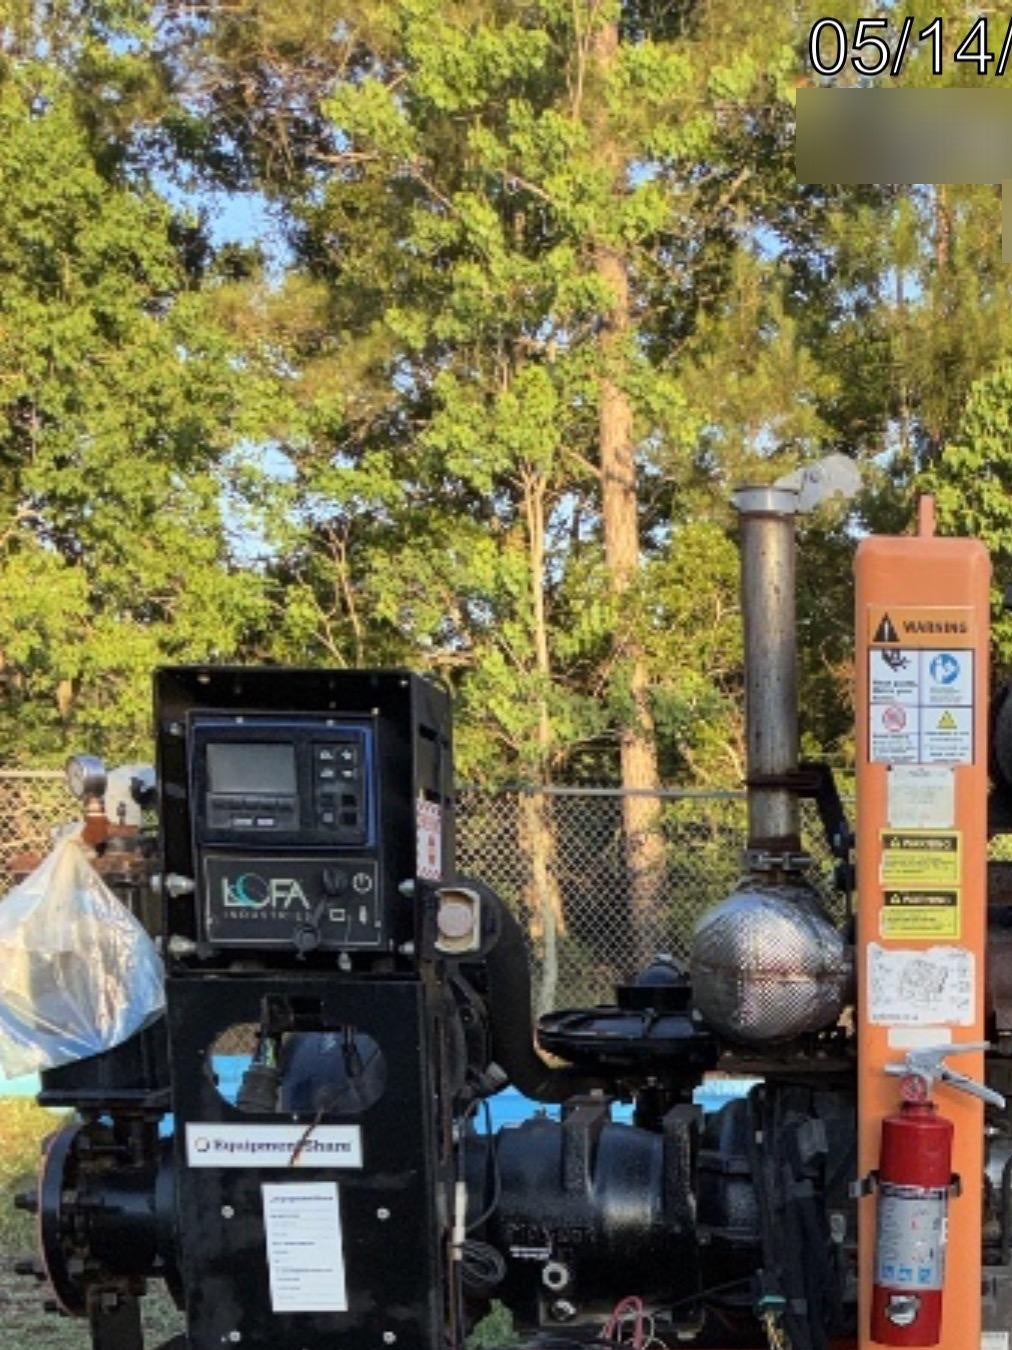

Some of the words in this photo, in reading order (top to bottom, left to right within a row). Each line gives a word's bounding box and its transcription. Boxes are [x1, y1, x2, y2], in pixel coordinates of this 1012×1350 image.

[902, 620, 968, 633] WARNING
[221, 873, 310, 909] LOFA
[212, 1138, 352, 1154] EquipmenShare
